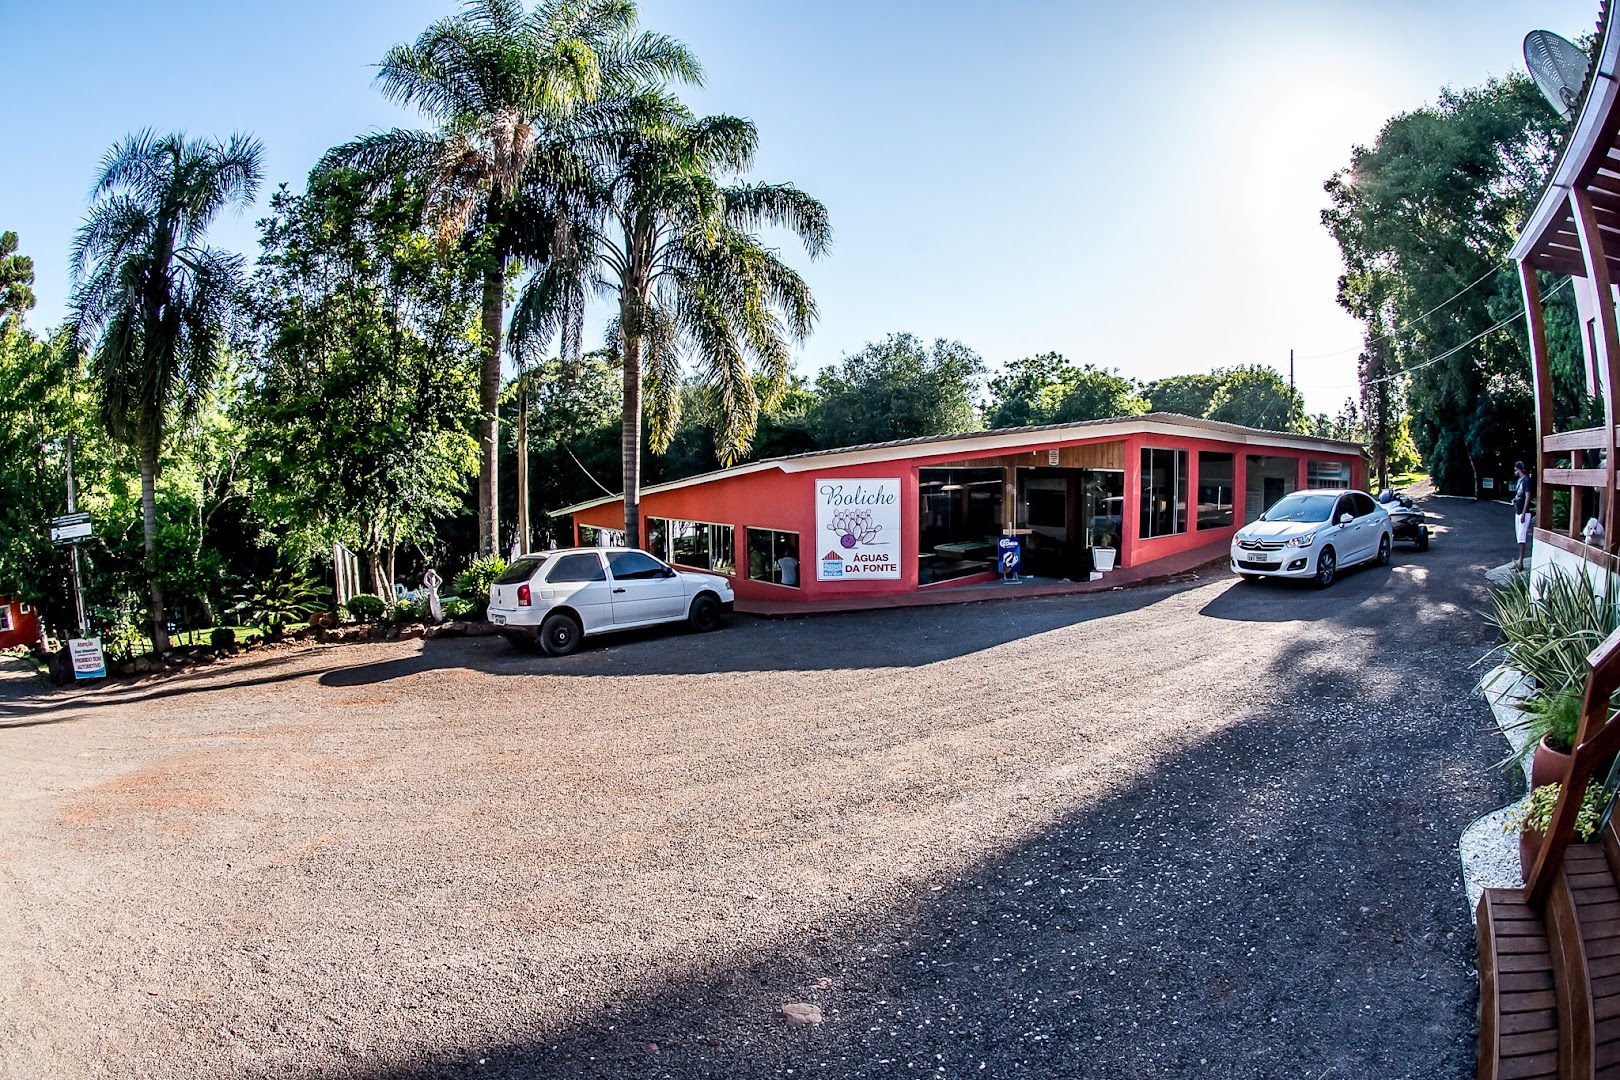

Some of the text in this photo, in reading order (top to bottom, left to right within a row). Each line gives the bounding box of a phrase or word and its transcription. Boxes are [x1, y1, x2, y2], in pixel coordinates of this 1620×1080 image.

[820, 485, 897, 506] Boliche
[853, 553, 889, 562] ÁGUAS
[845, 564, 897, 573] DA FONTE
